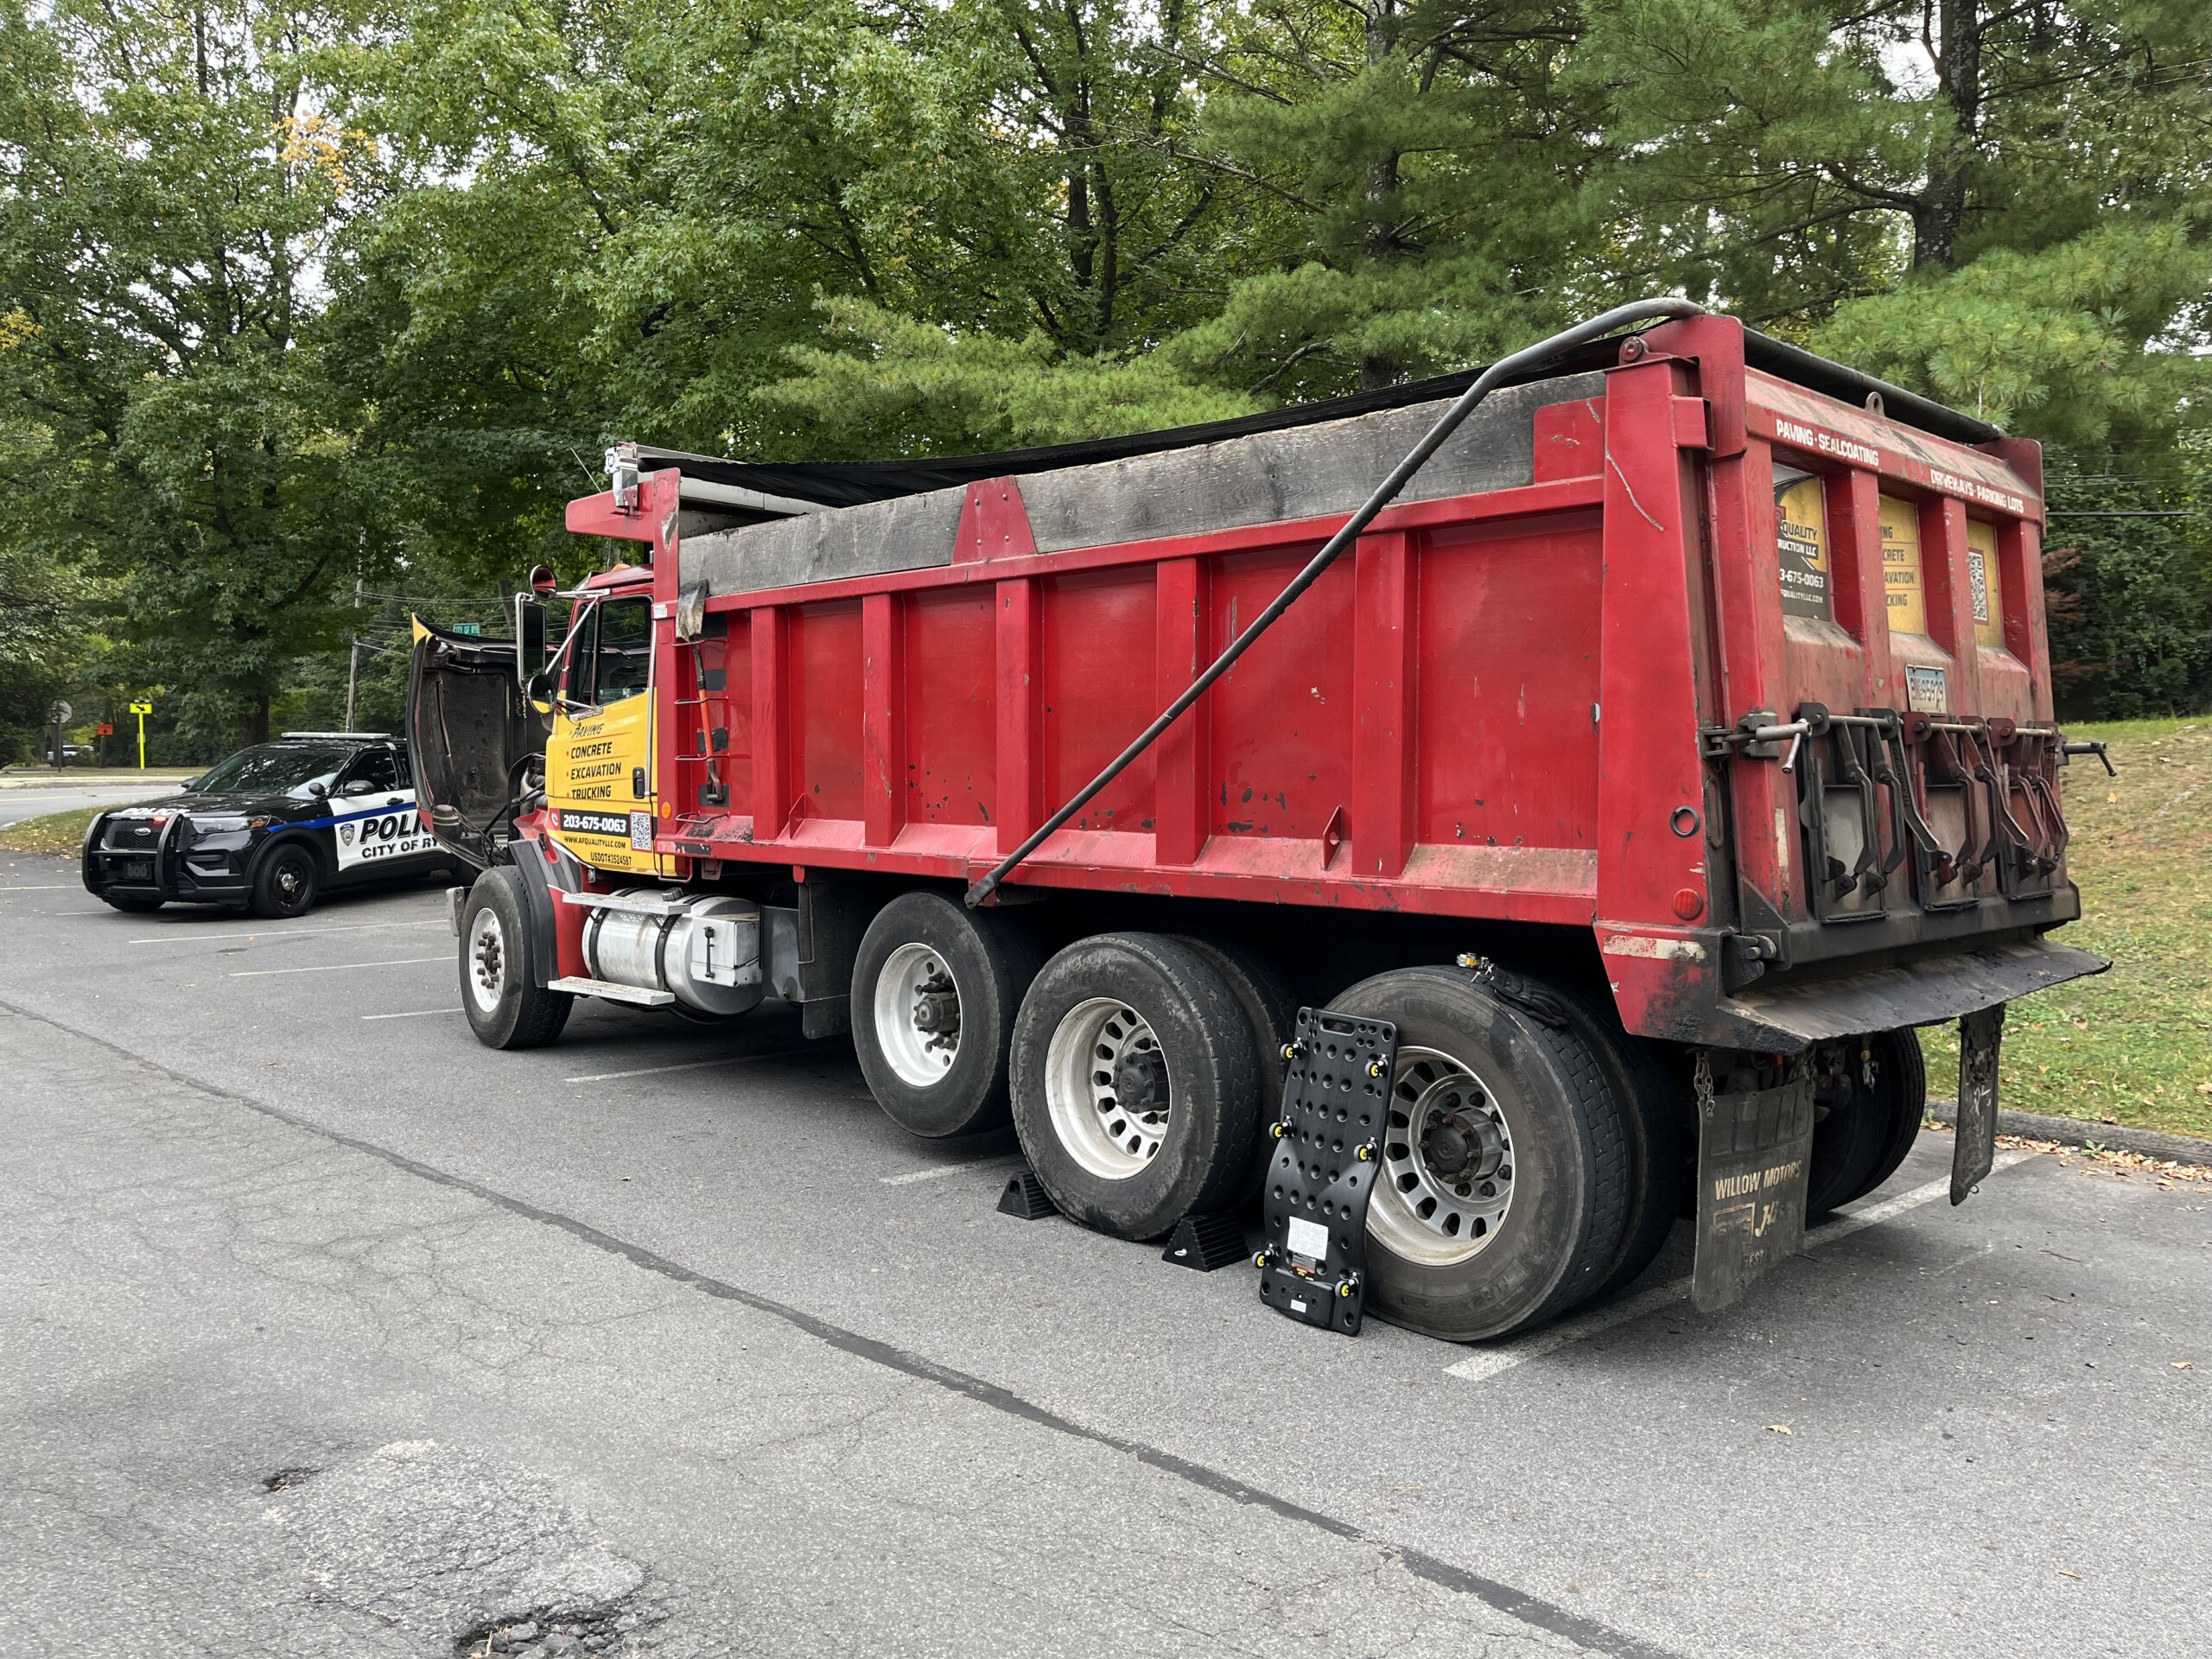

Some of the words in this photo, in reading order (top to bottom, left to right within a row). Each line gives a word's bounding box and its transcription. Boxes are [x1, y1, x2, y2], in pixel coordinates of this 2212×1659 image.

[1776, 419, 1814, 447] PAVING
[1818, 434, 1878, 467] SEALCOATING
[2007, 495, 2024, 514] LOTS
[1781, 520, 1818, 541] QUALITY
[1805, 545, 1817, 557] LLC
[571, 723, 605, 739] PAVING
[570, 741, 613, 760] CONCRETE
[570, 762, 622, 780] EXCAVATION
[571, 785, 612, 800] TRUCKING
[359, 813, 431, 845] POLI
[563, 814, 626, 833] 203-675-0063
[361, 842, 397, 859] CITY
[400, 839, 419, 853] OF
[422, 835, 439, 849] RY
[563, 835, 626, 849] WWW.AFQUALITYLLC.COM
[1715, 1171, 1762, 1200] WILLOW
[1763, 1159, 1802, 1189] MOTORS
